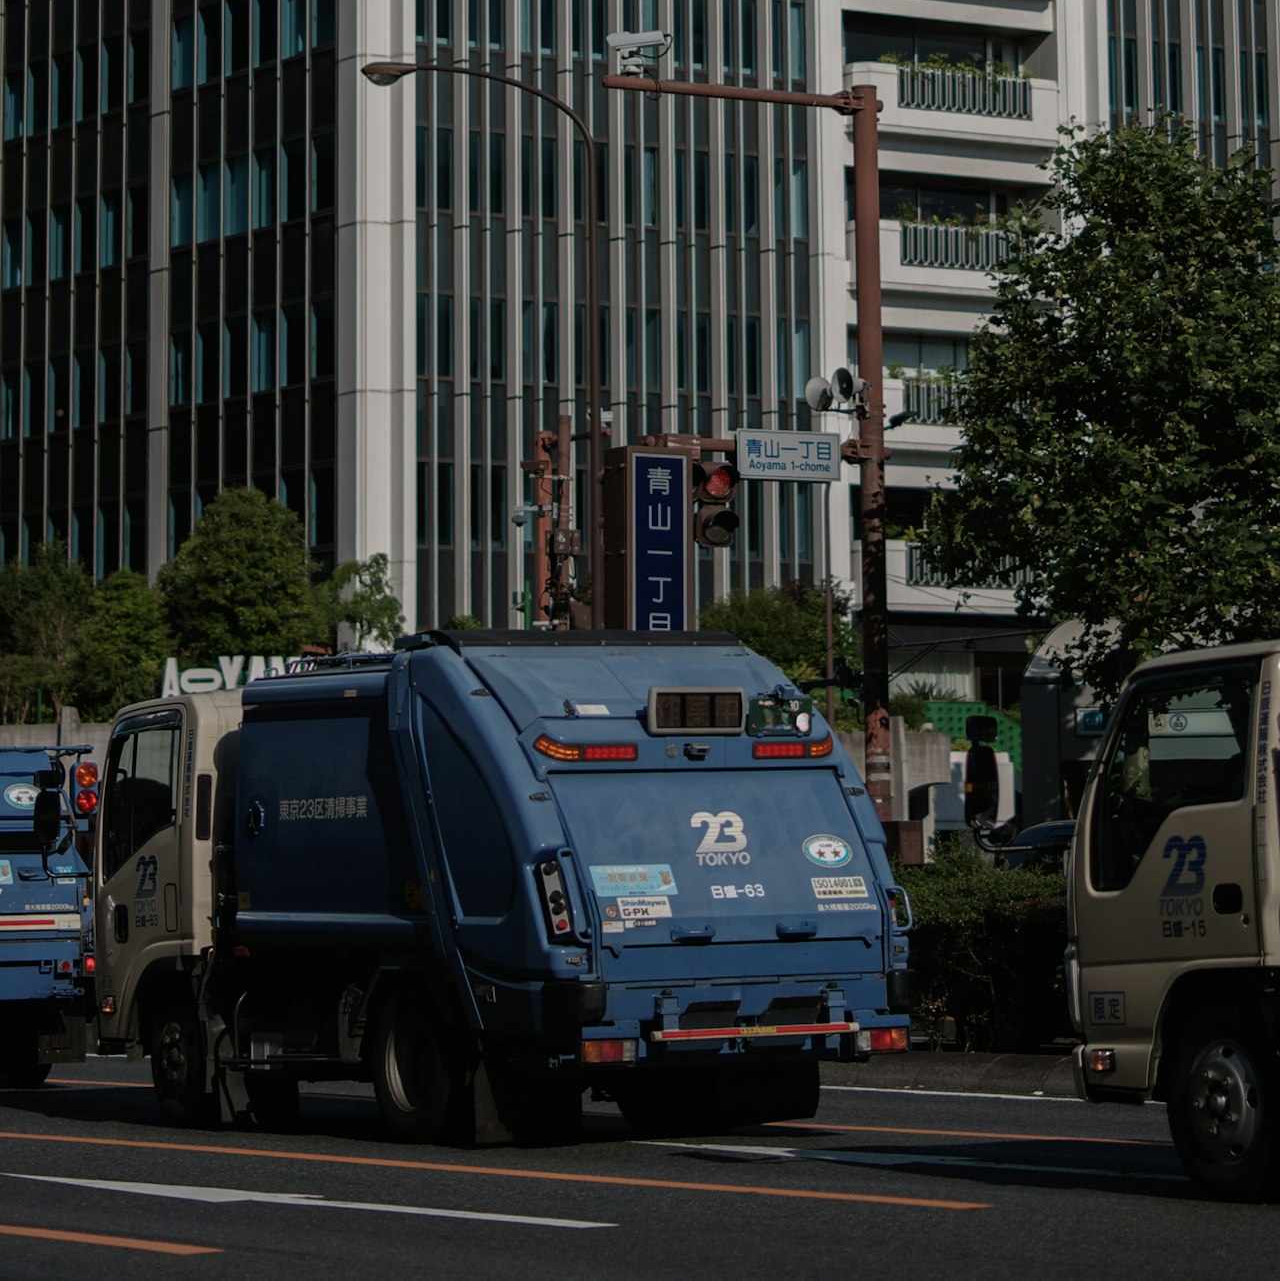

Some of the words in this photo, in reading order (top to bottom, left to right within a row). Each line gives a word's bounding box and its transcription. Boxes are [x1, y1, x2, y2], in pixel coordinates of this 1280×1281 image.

[746, 439, 831, 460] 青山一丁目
[749, 459, 787, 472] Aoyama
[791, 461, 830, 472] 1-chome
[647, 467, 673, 631] 青山一丁目
[279, 795, 368, 821] 東京23区清掃事業
[690, 811, 748, 853] 23
[695, 851, 751, 866] TOKYO
[1161, 835, 1206, 897] 23
[135, 854, 158, 899] 23
[813, 878, 854, 889] ISO14001
[710, 883, 765, 899] 日盛-63
[134, 899, 157, 913] TOKYO
[621, 899, 667, 908] ShinMaywa
[622, 908, 650, 916] G-PX
[1159, 898, 1204, 917] TOKYO
[1163, 919, 1207, 937] 日盛-15
